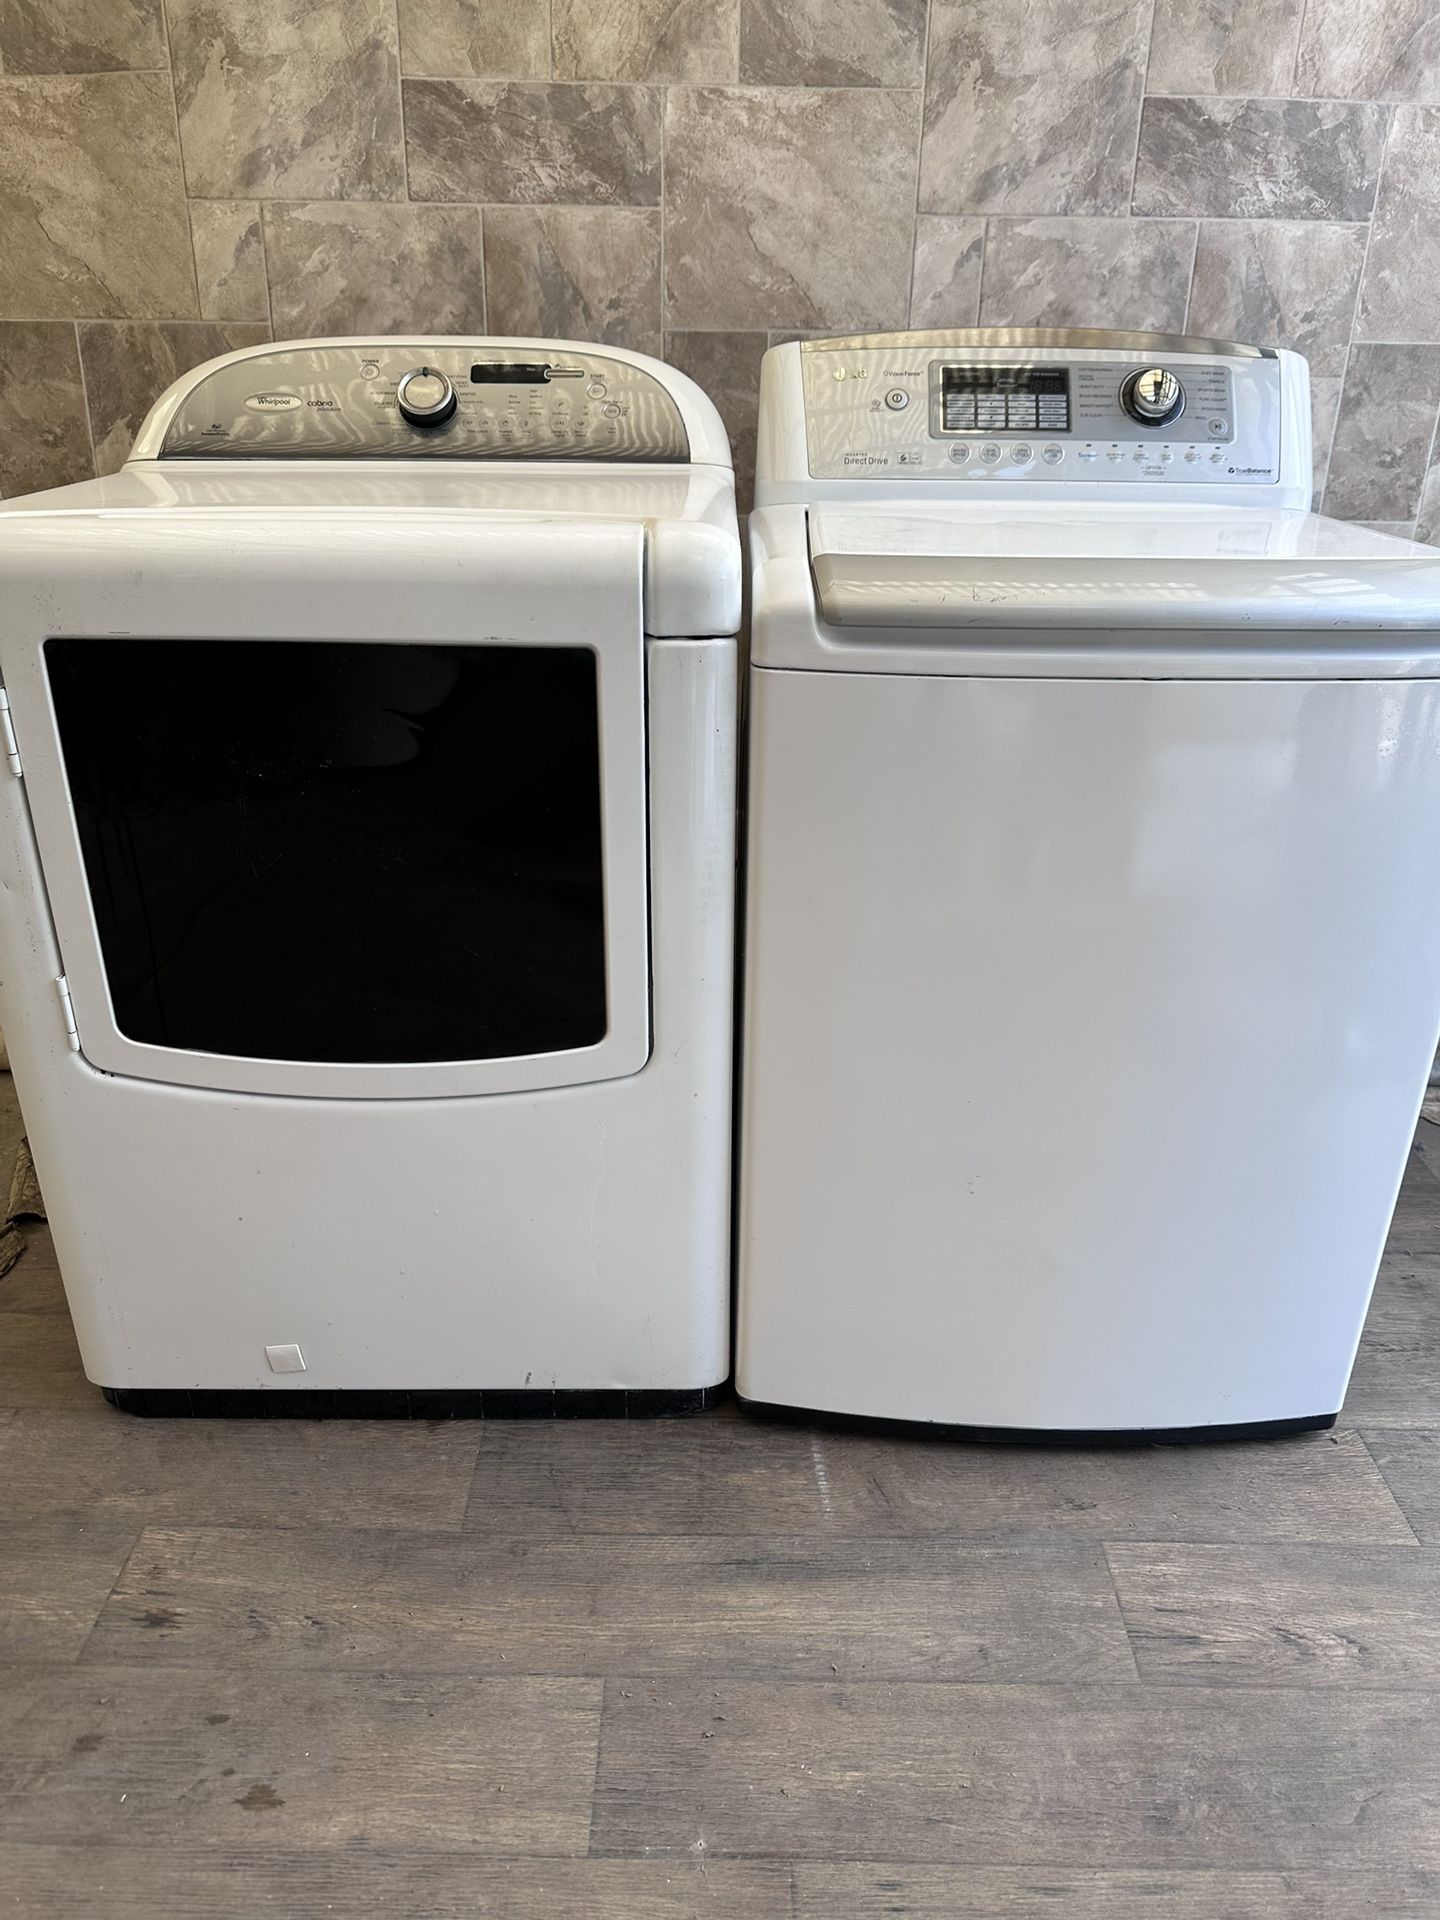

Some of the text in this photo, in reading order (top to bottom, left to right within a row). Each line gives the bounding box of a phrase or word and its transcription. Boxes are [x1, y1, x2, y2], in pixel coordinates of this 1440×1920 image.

[257, 396, 291, 406] Whirlpool
[844, 457, 867, 465] Direct
[869, 457, 889, 465] Drive
